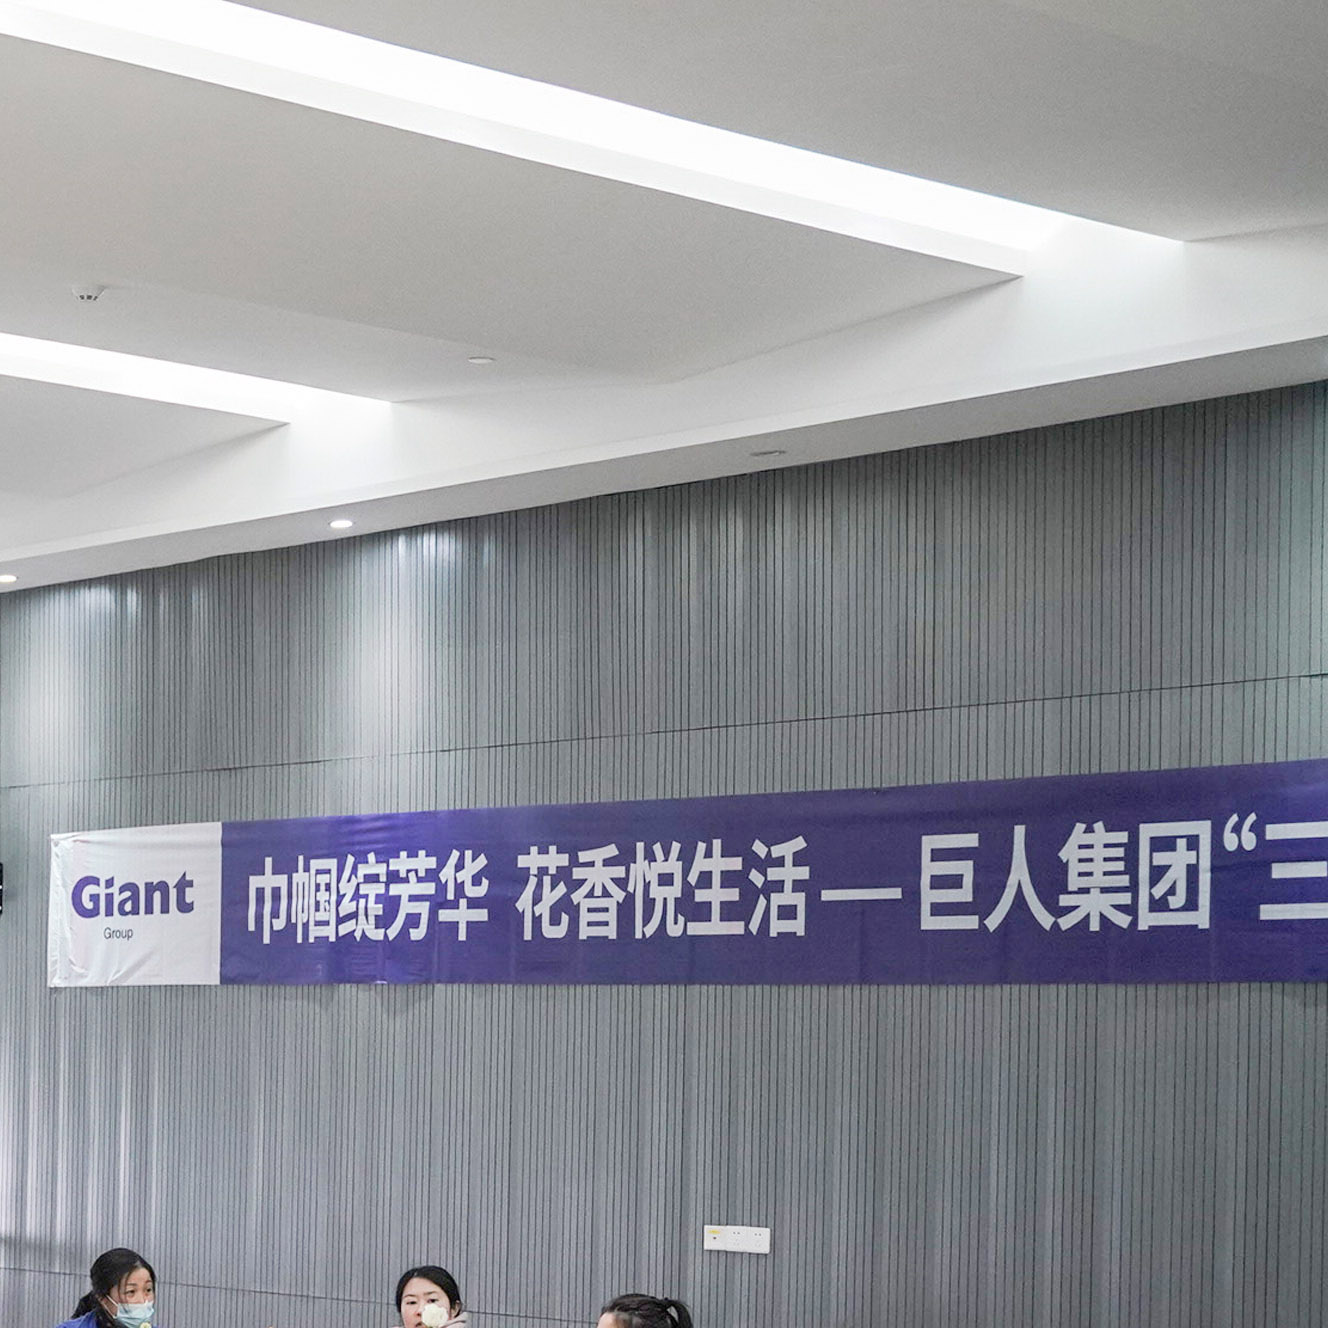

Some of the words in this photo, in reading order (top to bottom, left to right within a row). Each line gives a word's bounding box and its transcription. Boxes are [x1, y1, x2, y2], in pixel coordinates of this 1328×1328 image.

[71, 871, 194, 919] Giant
[247, 849, 489, 944] 巾帼绽芳华
[103, 926, 134, 941] Group
